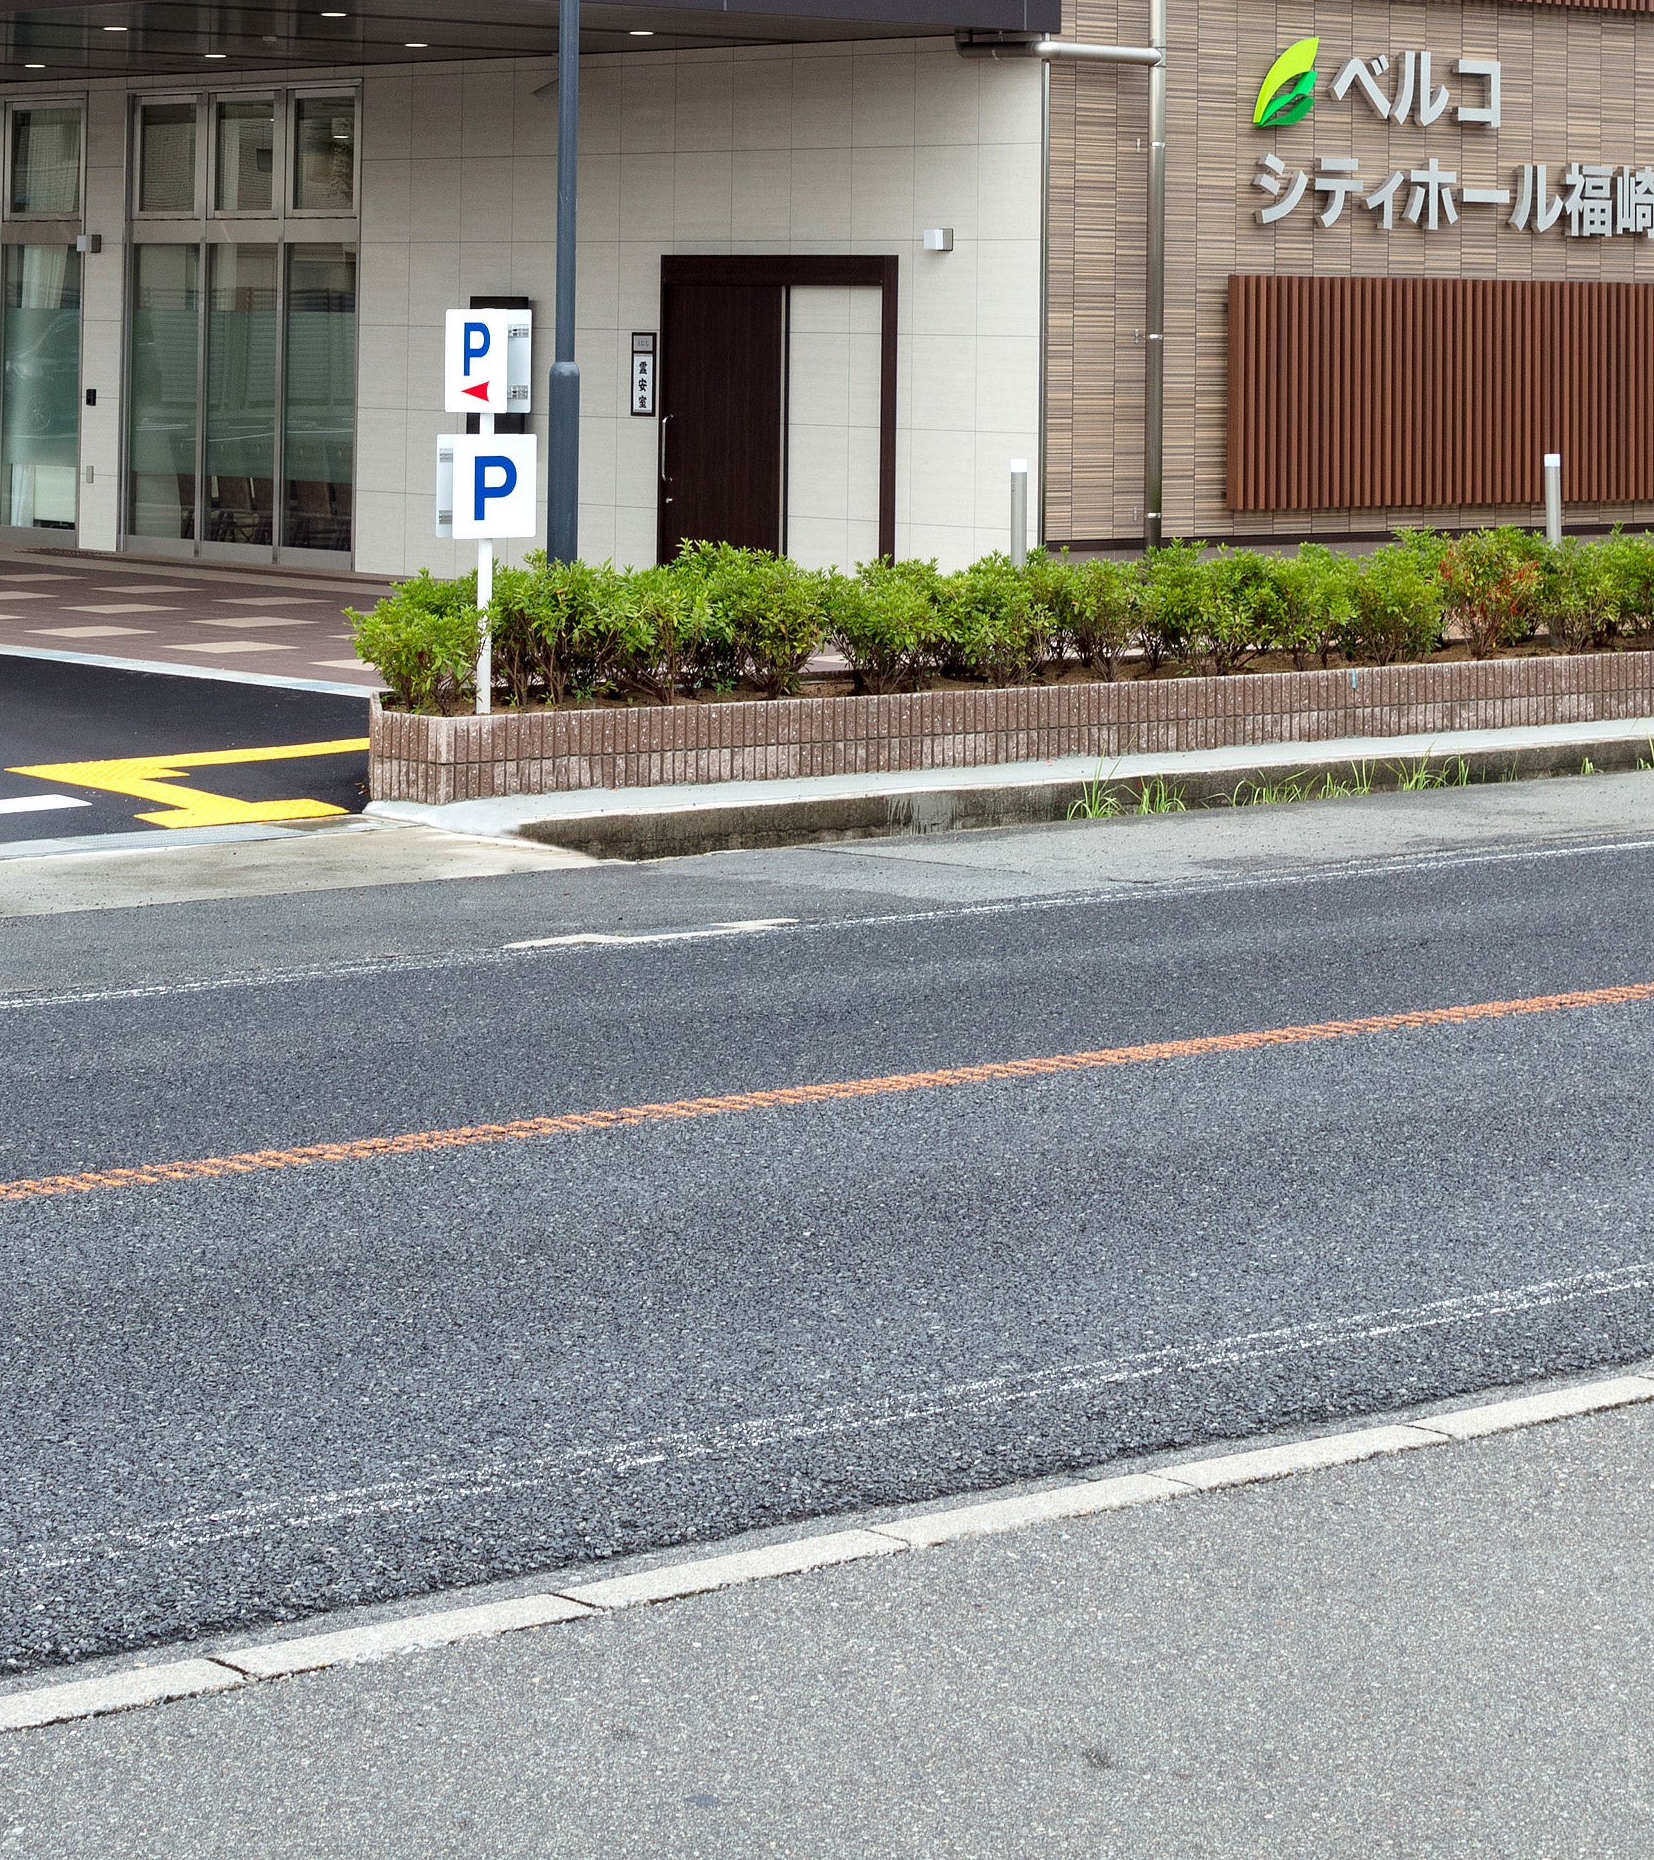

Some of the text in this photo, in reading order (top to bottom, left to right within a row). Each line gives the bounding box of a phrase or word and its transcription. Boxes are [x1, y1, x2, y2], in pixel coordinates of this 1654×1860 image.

[1328, 50, 1501, 129] ベルコ
[464, 322, 490, 376] P
[638, 361, 648, 408] 霊安室
[474, 456, 518, 521] P
